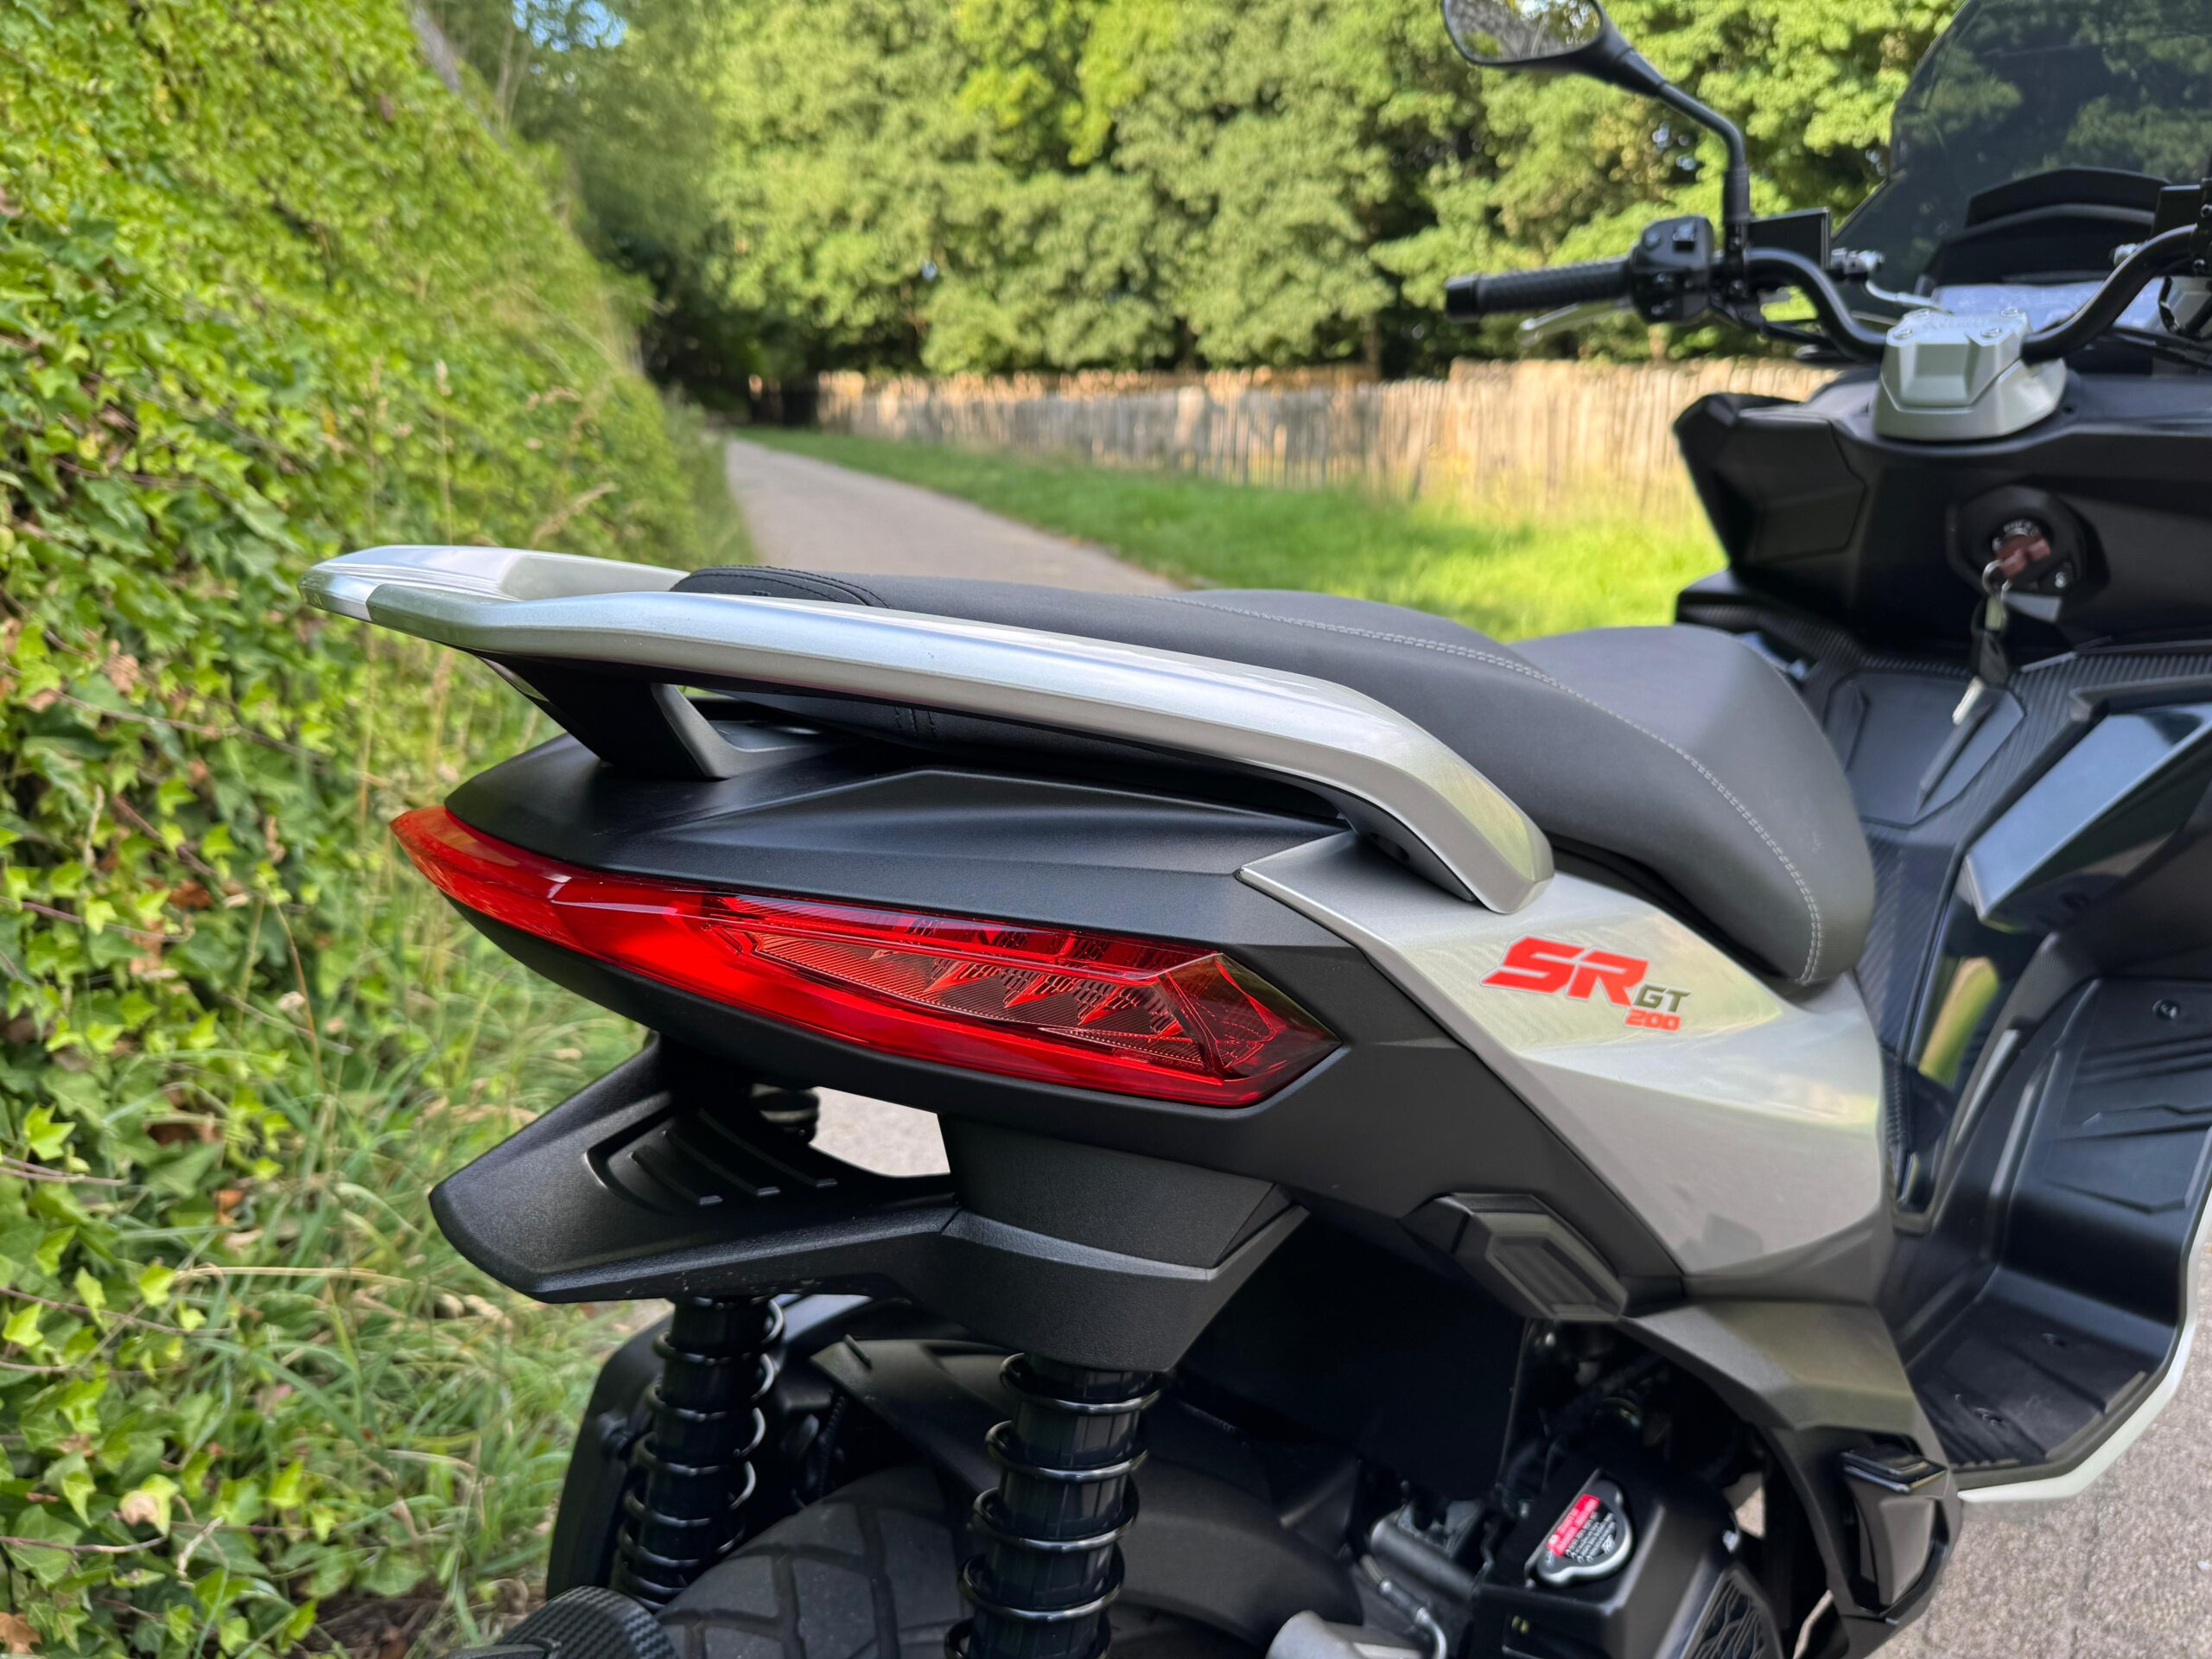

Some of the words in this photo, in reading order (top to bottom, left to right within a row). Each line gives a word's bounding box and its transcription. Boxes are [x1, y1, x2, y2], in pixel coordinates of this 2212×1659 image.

[1482, 936, 1649, 1007] SR
[1634, 984, 1691, 1013] GT
[1625, 1007, 1681, 1032] 200
